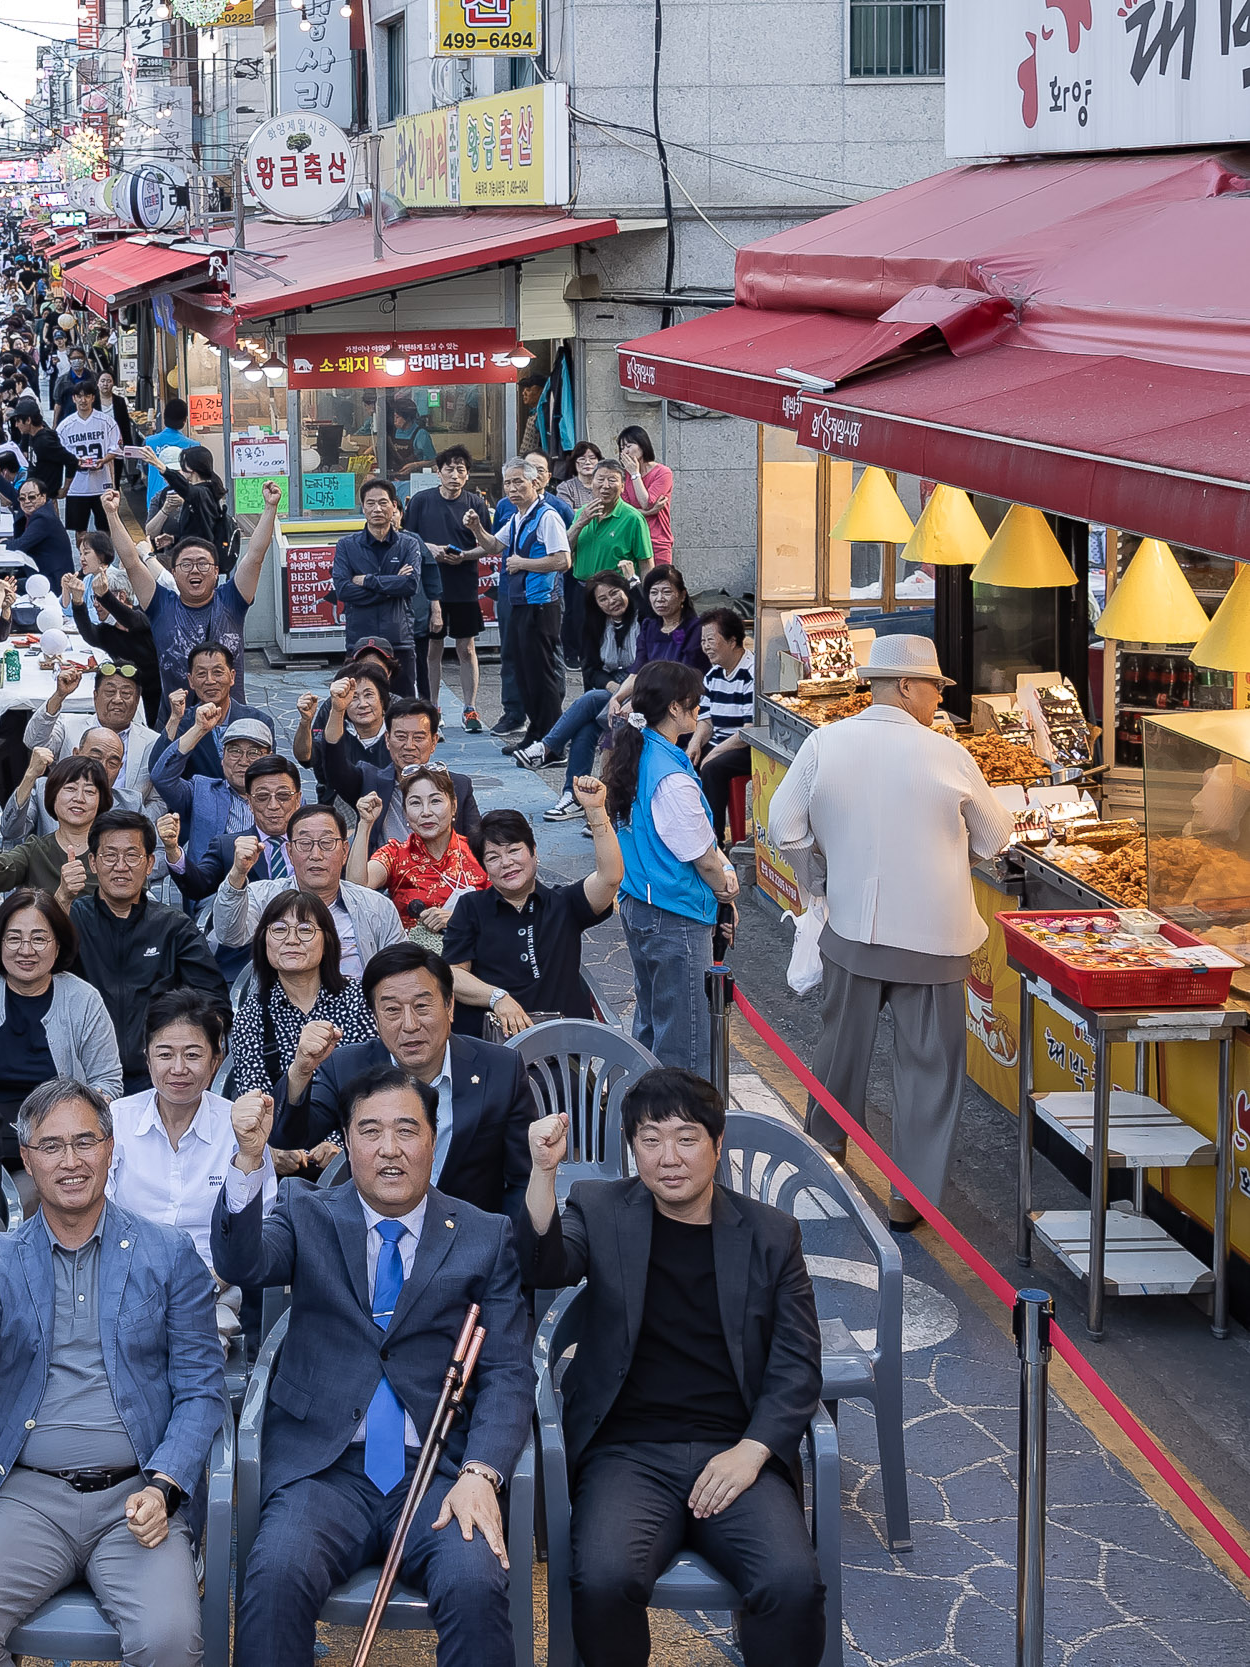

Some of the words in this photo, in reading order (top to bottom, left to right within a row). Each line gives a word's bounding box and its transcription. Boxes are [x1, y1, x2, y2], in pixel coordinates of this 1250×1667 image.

[443, 32, 533, 48] 499-6494
[1049, 76, 1092, 127] 화양
[267, 118, 328, 141] 화양제일시장
[466, 105, 534, 172] 황금축산
[256, 151, 347, 190] 황금축산
[424, 343, 437, 351] 드실
[438, 342, 445, 350] 수
[446, 342, 459, 350] 있는
[408, 353, 485, 370] 판매합니다
[811, 407, 862, 451] 화양제일시장
[289, 552, 297, 560] 제
[290, 572, 318, 582] BEER
[291, 582, 336, 592] FESTIVA
[291, 604, 317, 614] 뜨겁게
[531, 965, 540, 979] YOU
